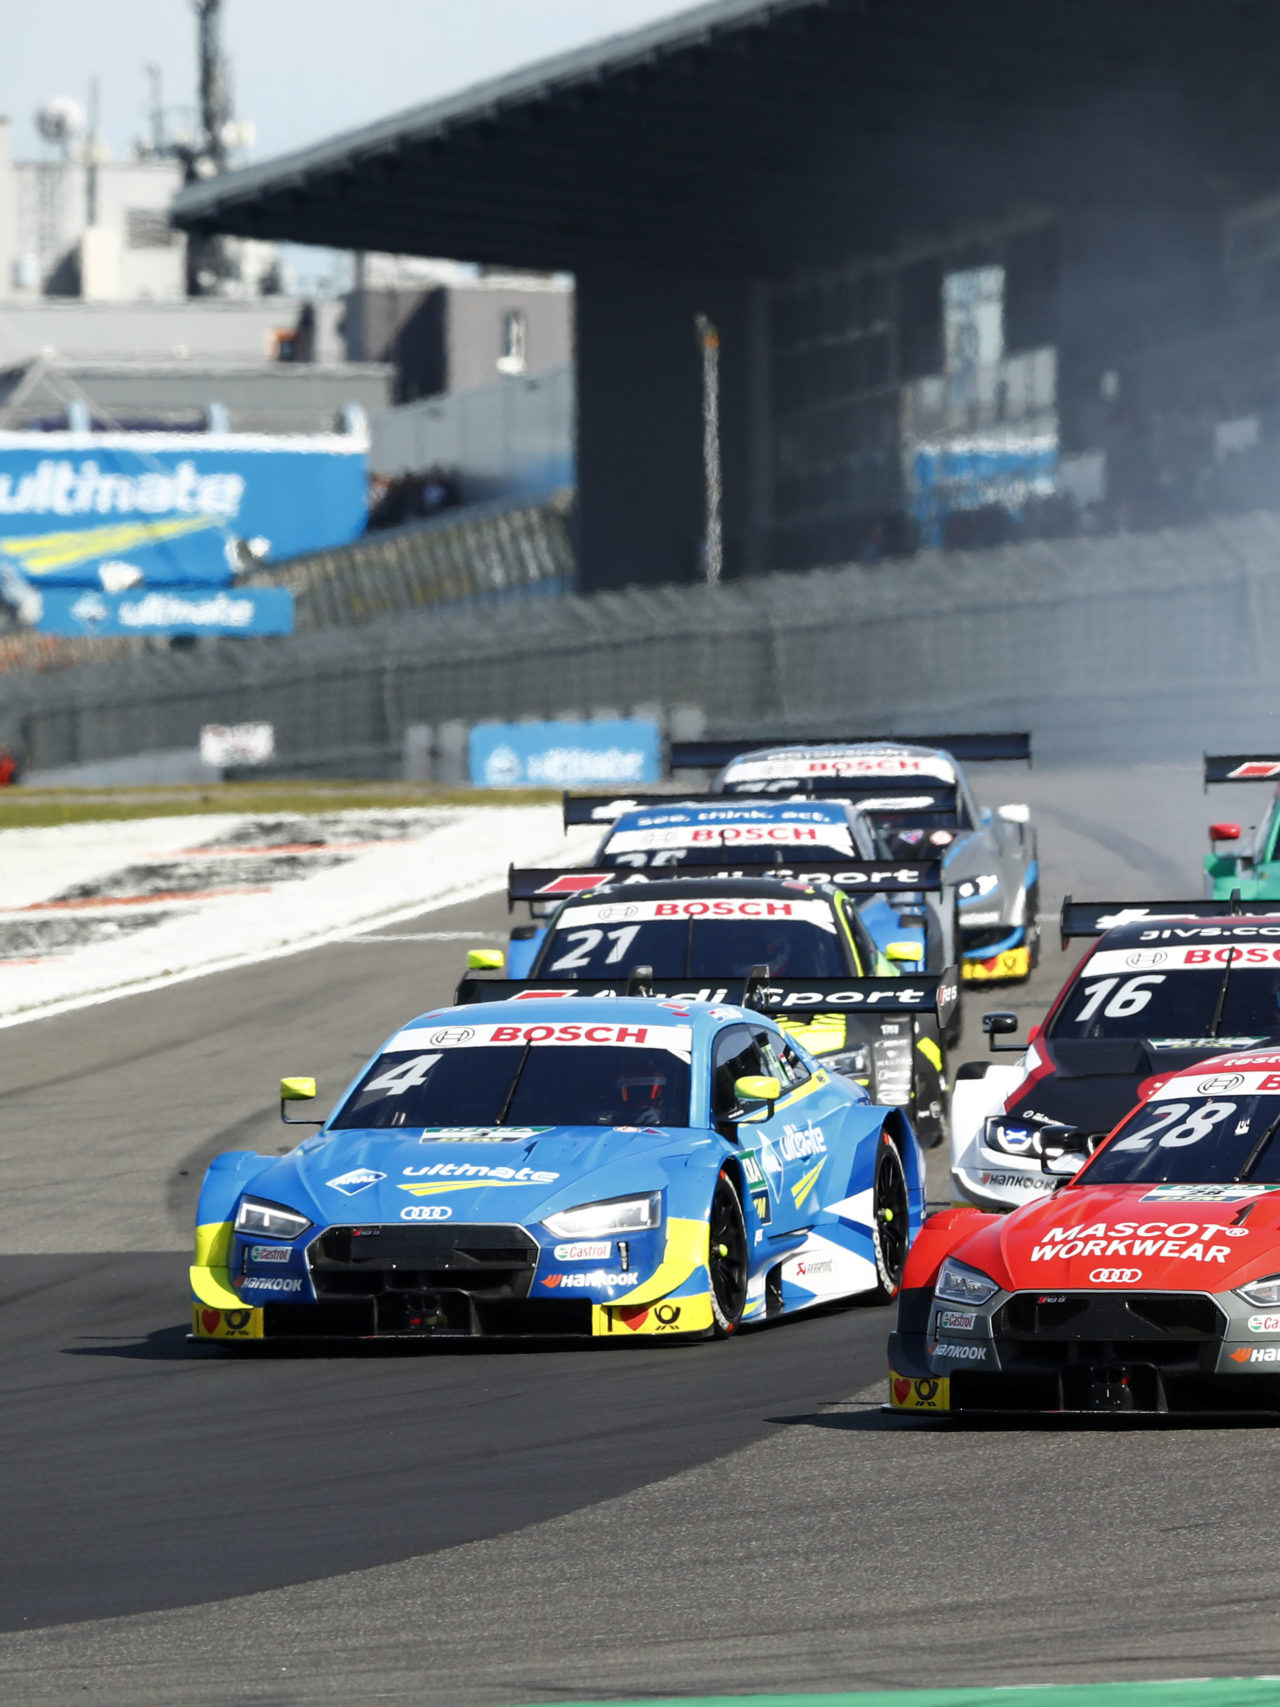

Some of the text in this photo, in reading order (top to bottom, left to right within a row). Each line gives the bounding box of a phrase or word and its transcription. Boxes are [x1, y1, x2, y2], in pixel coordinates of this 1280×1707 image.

[809, 759, 920, 772] BOSCH
[691, 827, 817, 842] BOSCH
[654, 902, 792, 917] BOSCH
[550, 925, 642, 972] 21
[1075, 974, 1166, 1022] 16
[489, 1026, 649, 1044] BOSCH
[363, 1054, 443, 1096] 4
[1110, 1102, 1237, 1152] 28
[402, 1163, 561, 1183] ultimate
[569, 1245, 608, 1259] Castrol
[1031, 1239, 1231, 1264] WORKWEAR
[948, 1314, 974, 1329] Castrol
